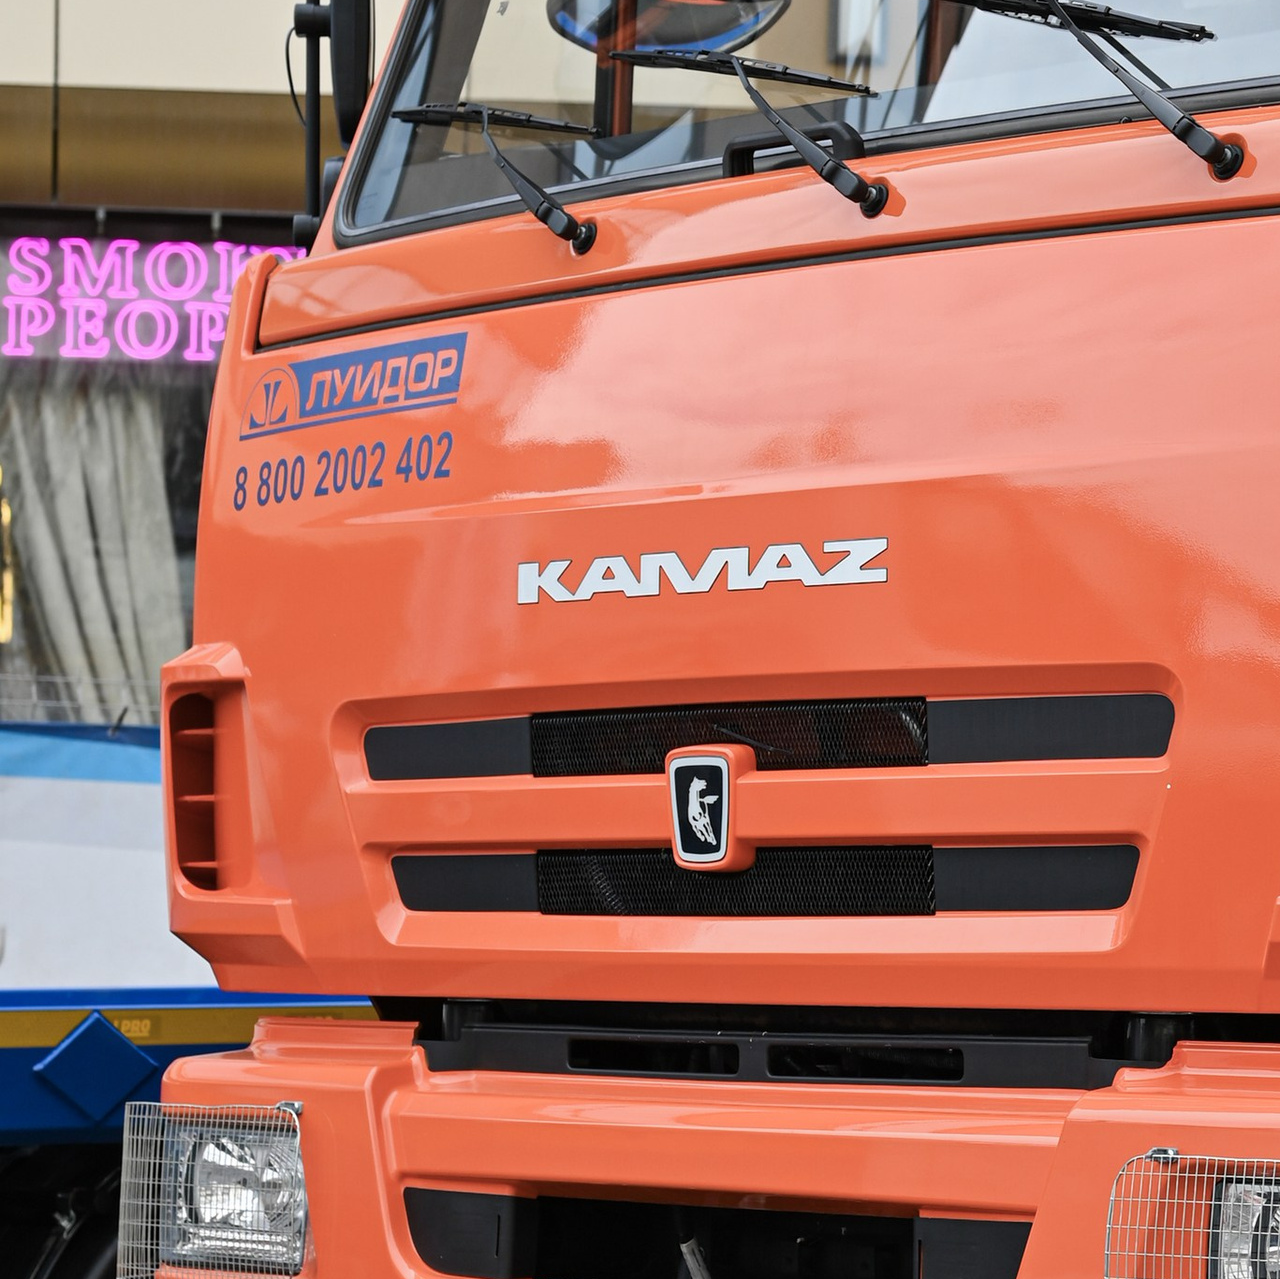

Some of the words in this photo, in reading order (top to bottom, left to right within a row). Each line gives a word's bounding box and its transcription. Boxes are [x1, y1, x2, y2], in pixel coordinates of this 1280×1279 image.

[305, 348, 458, 411] ЛУИДОР
[233, 466, 248, 511] 8
[257, 455, 305, 506] 800
[314, 441, 386, 497] 2002
[395, 430, 453, 483] 402
[517, 537, 888, 605] KAMAZ
